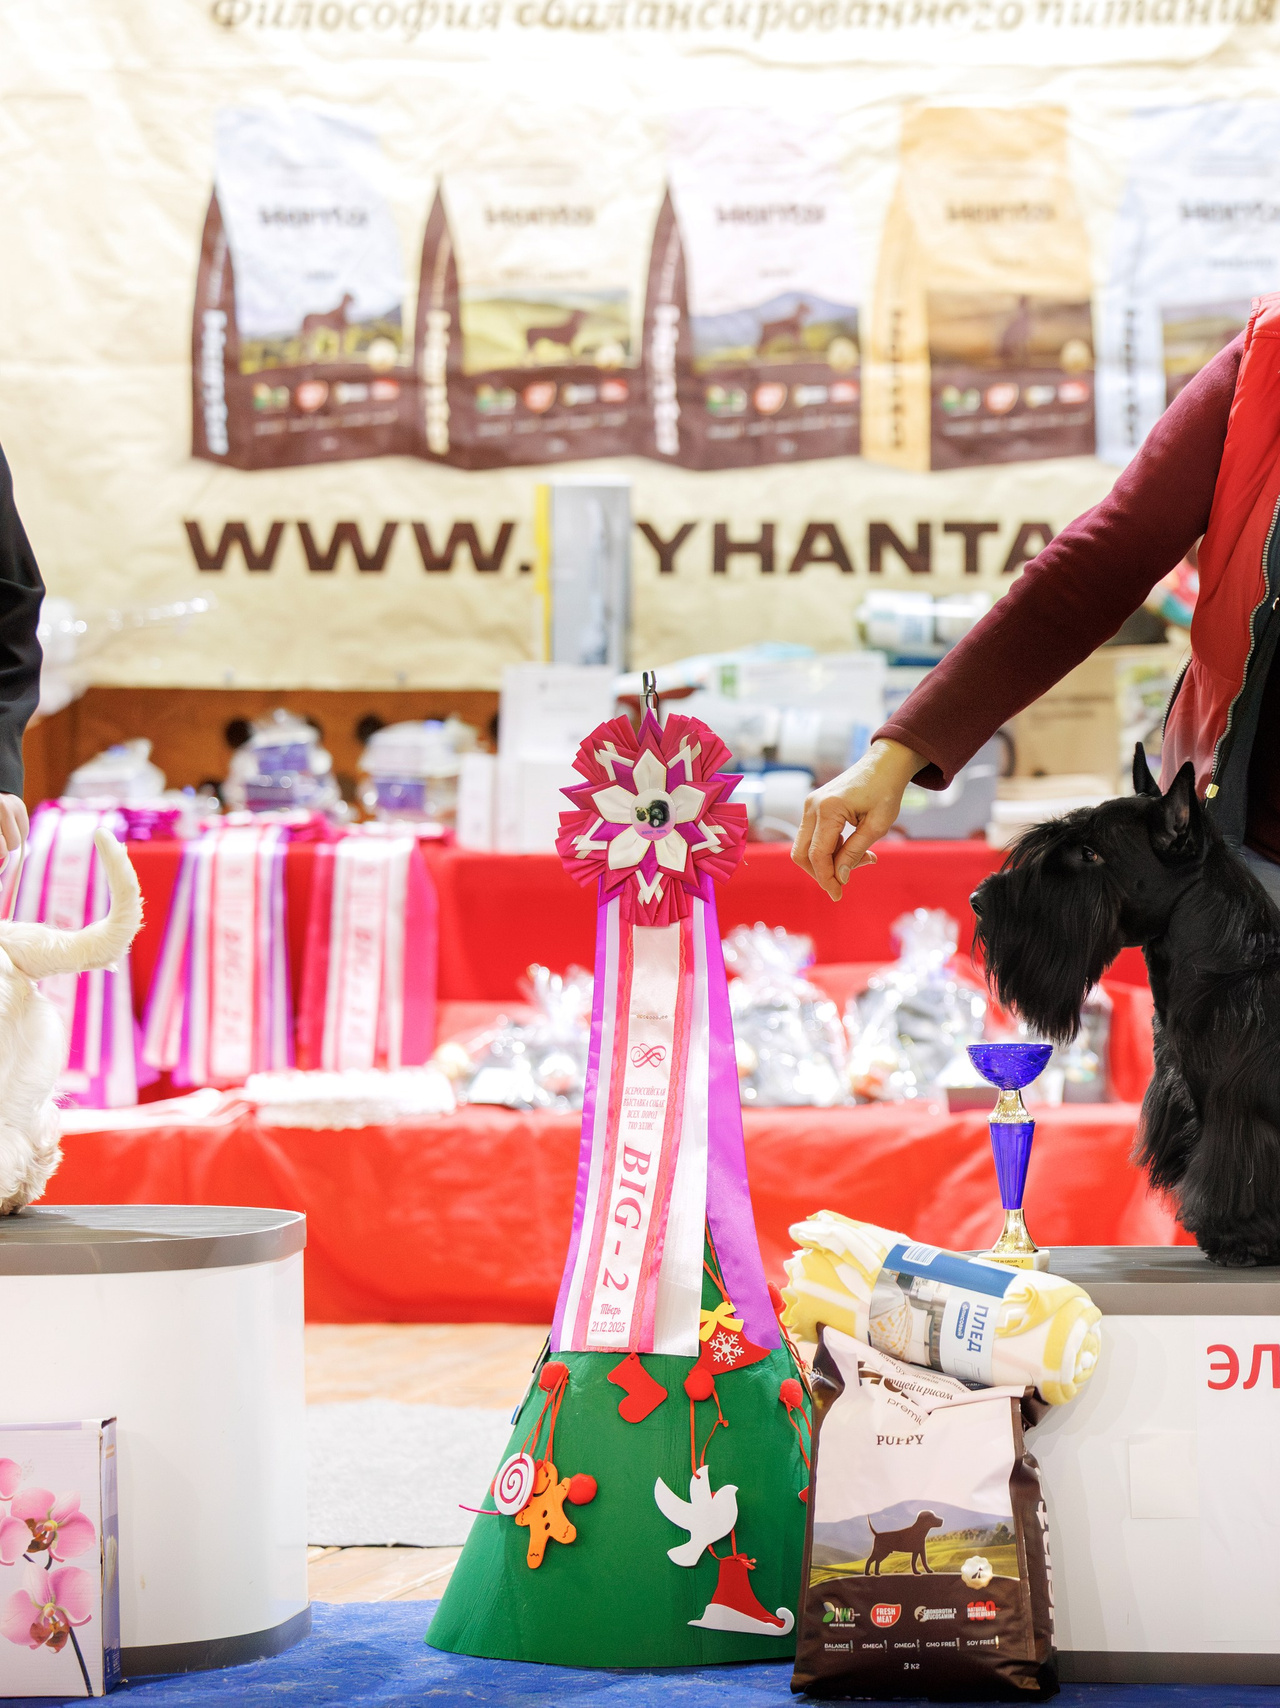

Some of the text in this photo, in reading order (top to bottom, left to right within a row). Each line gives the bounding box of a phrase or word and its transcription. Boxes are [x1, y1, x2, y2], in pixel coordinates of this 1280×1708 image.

[625, 1086, 666, 1096] ВСЕРОССИЙСКАЯ
[623, 1098, 649, 1107] ВЫСТАВКА
[626, 1110, 640, 1118] ВСЕХ
[614, 1142, 651, 1231] BIG
[602, 1267, 630, 1292] 2
[600, 1303, 622, 1320] Тверь
[591, 1321, 626, 1334] 21.12.2025
[967, 1304, 989, 1353] ПЛЕД
[921, 1386, 954, 1401] рисом
[876, 1434, 924, 1446] PUPPY
[876, 1607, 896, 1615] FRESH
[876, 1615, 893, 1623] MEAT
[903, 1662, 909, 1670] 3
